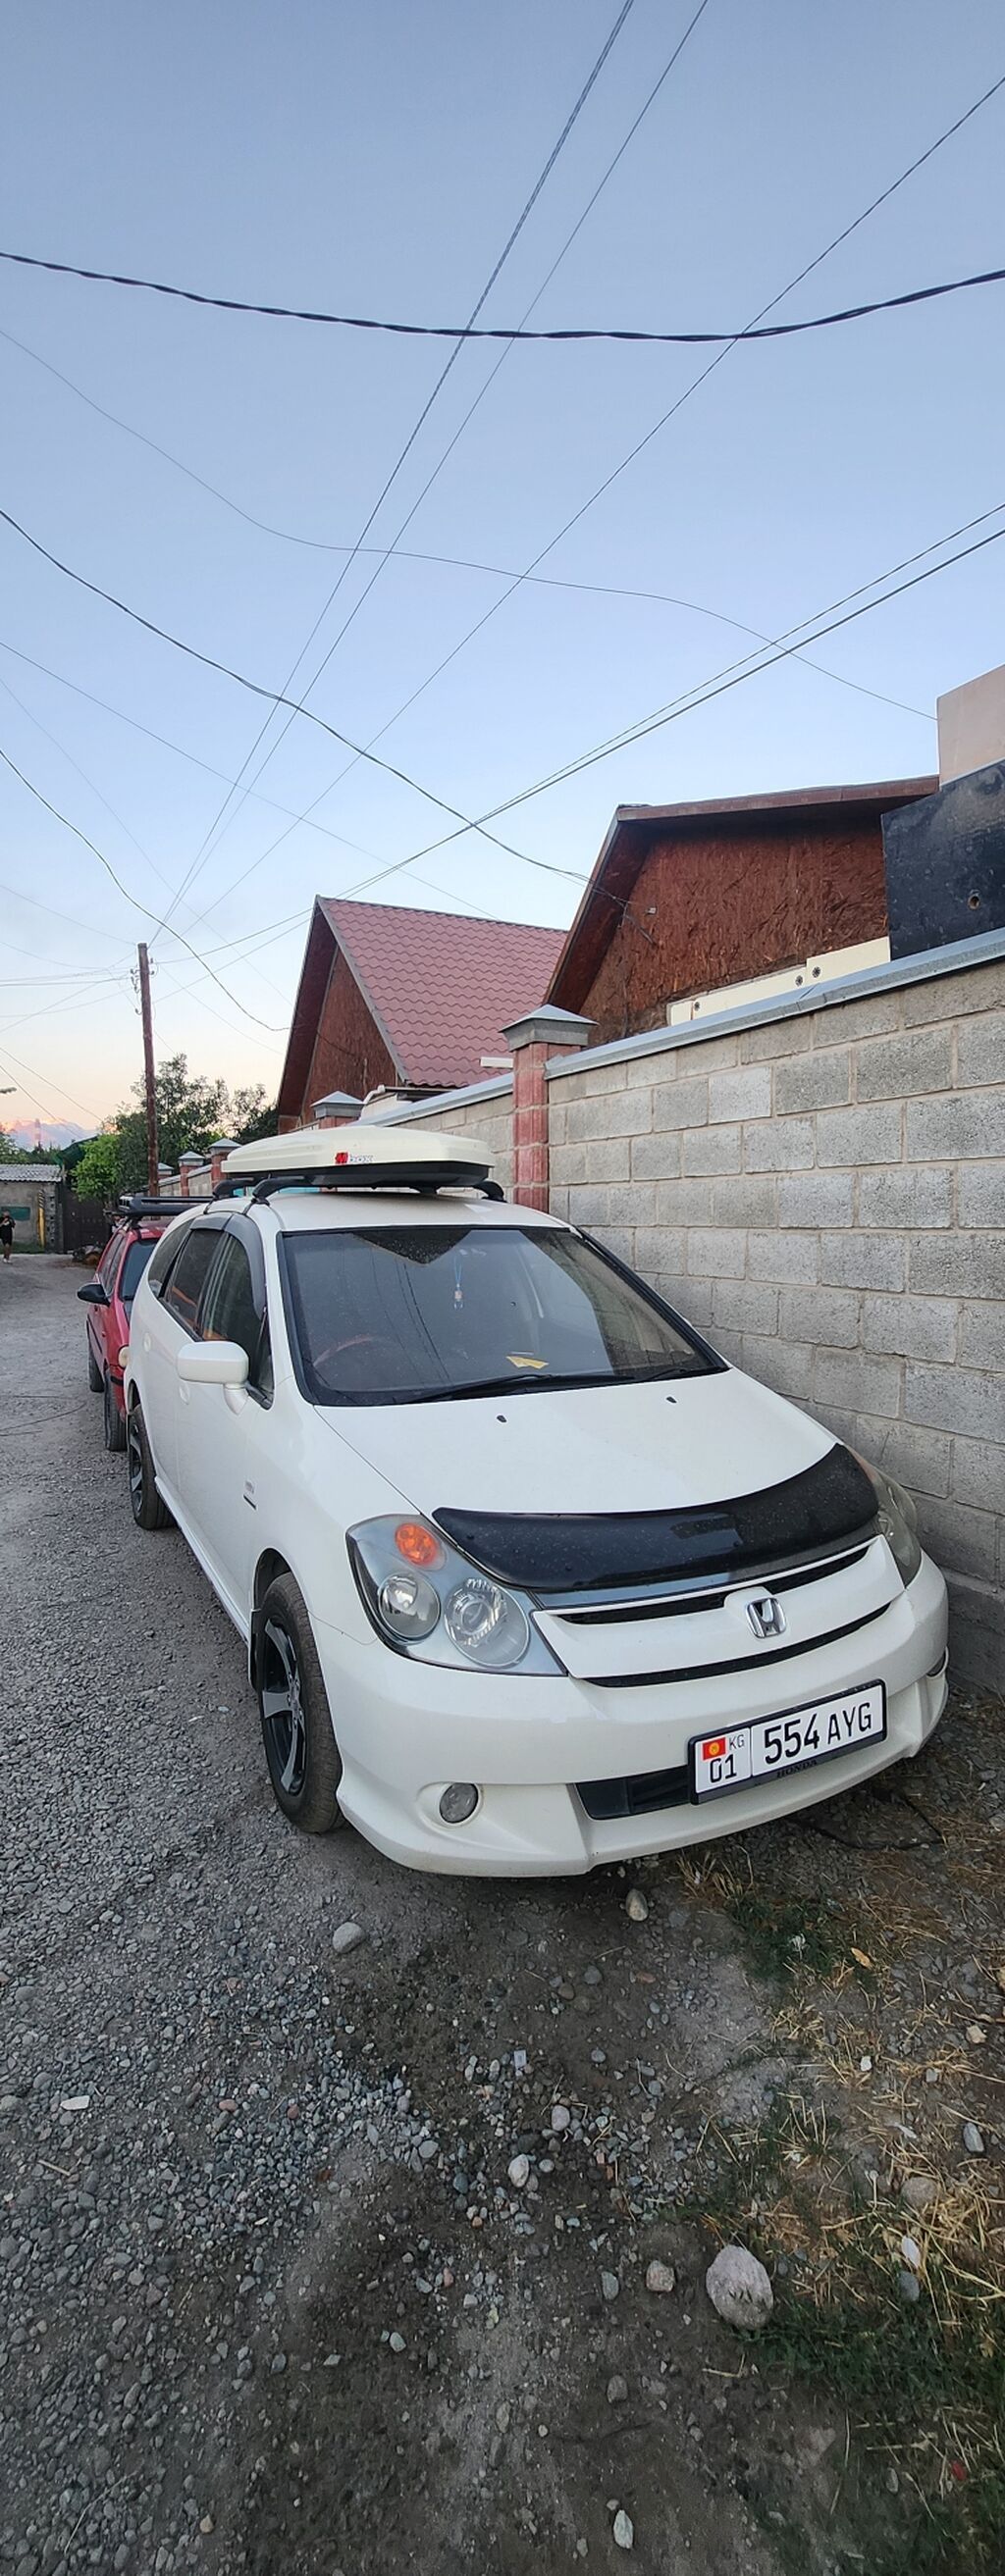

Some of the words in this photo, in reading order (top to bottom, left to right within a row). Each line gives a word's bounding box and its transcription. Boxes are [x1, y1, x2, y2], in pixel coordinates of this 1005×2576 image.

[728, 1734, 745, 1750] KG
[764, 1714, 820, 1764] 554
[827, 1702, 872, 1745] AYG
[710, 1754, 737, 1783] 01
[776, 1760, 818, 1778] HONDA
